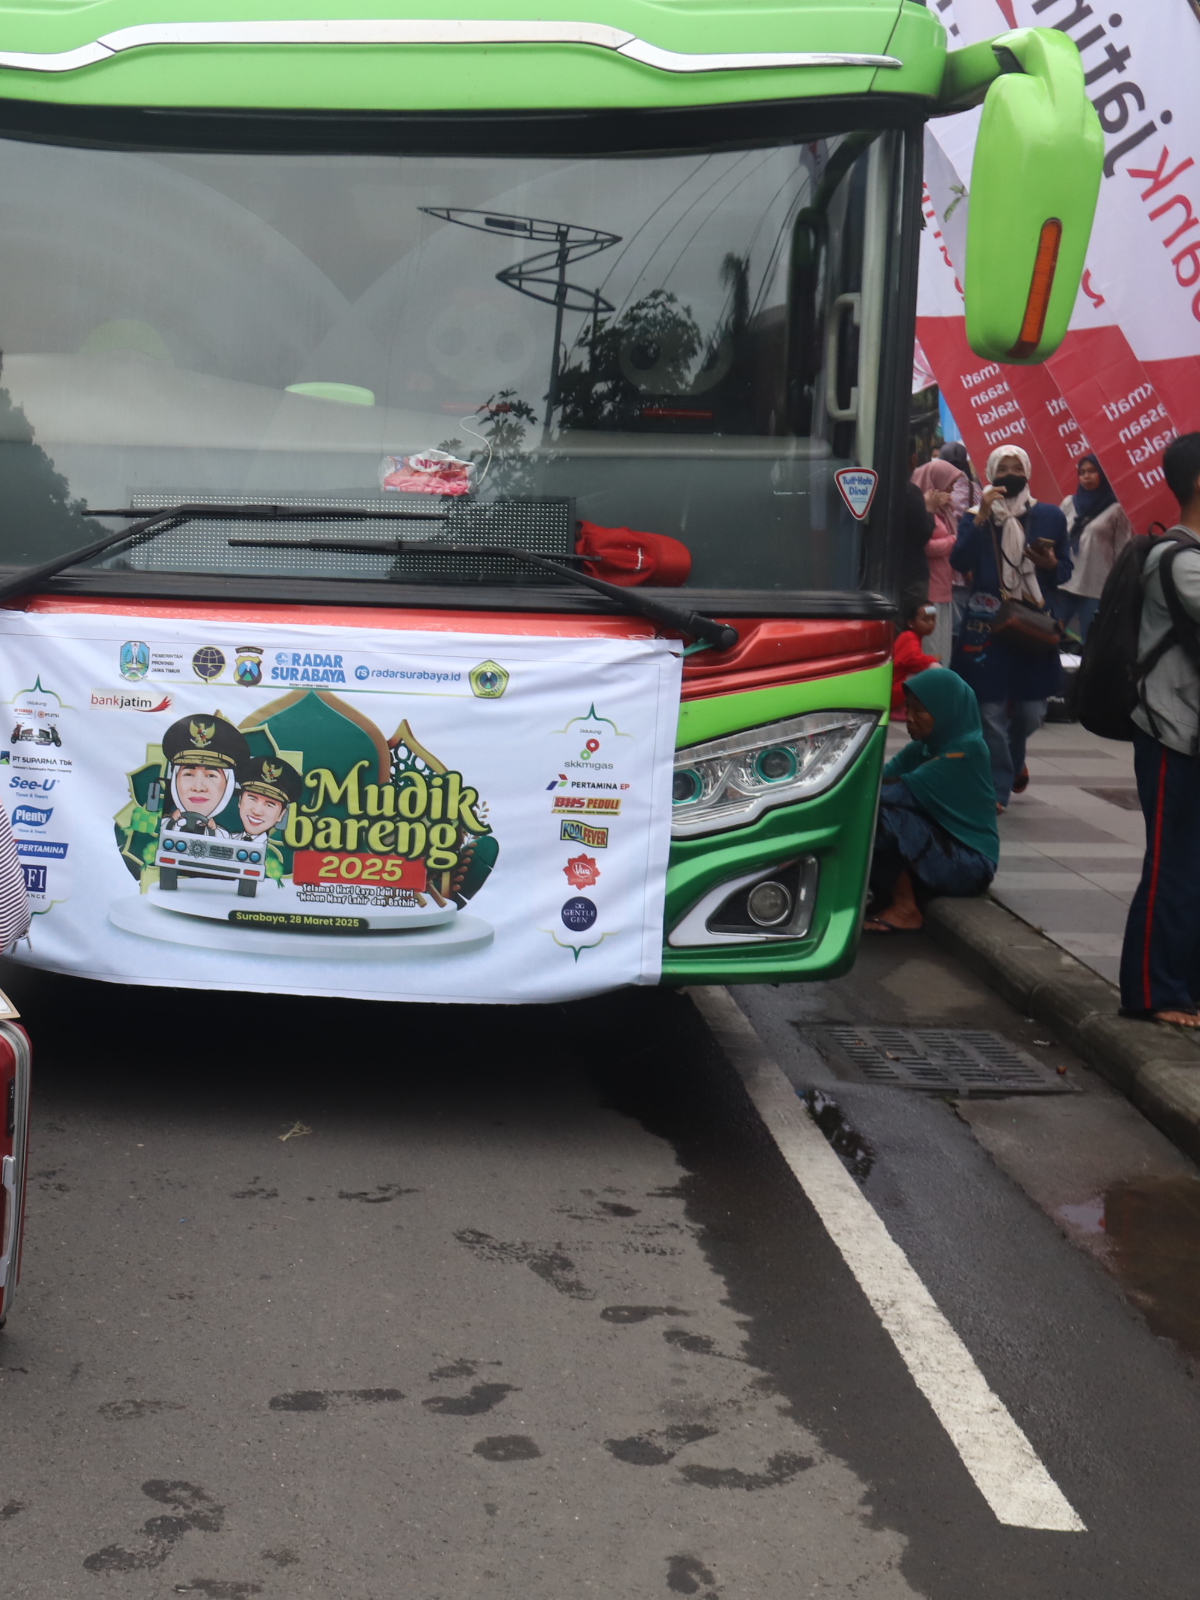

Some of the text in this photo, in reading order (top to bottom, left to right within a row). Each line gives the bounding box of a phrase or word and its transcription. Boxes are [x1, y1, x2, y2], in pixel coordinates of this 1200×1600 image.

[291, 652, 343, 668] RADAR
[270, 666, 347, 684] SURABAYA
[371, 669, 462, 683] radarsurabaya.id
[22, 757, 58, 765] SUPARMA
[564, 760, 614, 770] skkmigas
[8, 776, 57, 791] See-U
[571, 781, 618, 790] PERTAMINA
[301, 760, 492, 832] Mudik
[586, 798, 621, 810] PEDULI
[15, 808, 47, 824] Plenty
[284, 802, 459, 870] bareng
[16, 843, 65, 855] PERTAMINA
[318, 855, 404, 882] 2025
[336, 885, 354, 894] Hari
[355, 886, 375, 896] Raya
[236, 912, 360, 927] Surabaya, 28 Maret 2025
[563, 909, 596, 917] GENTLE
